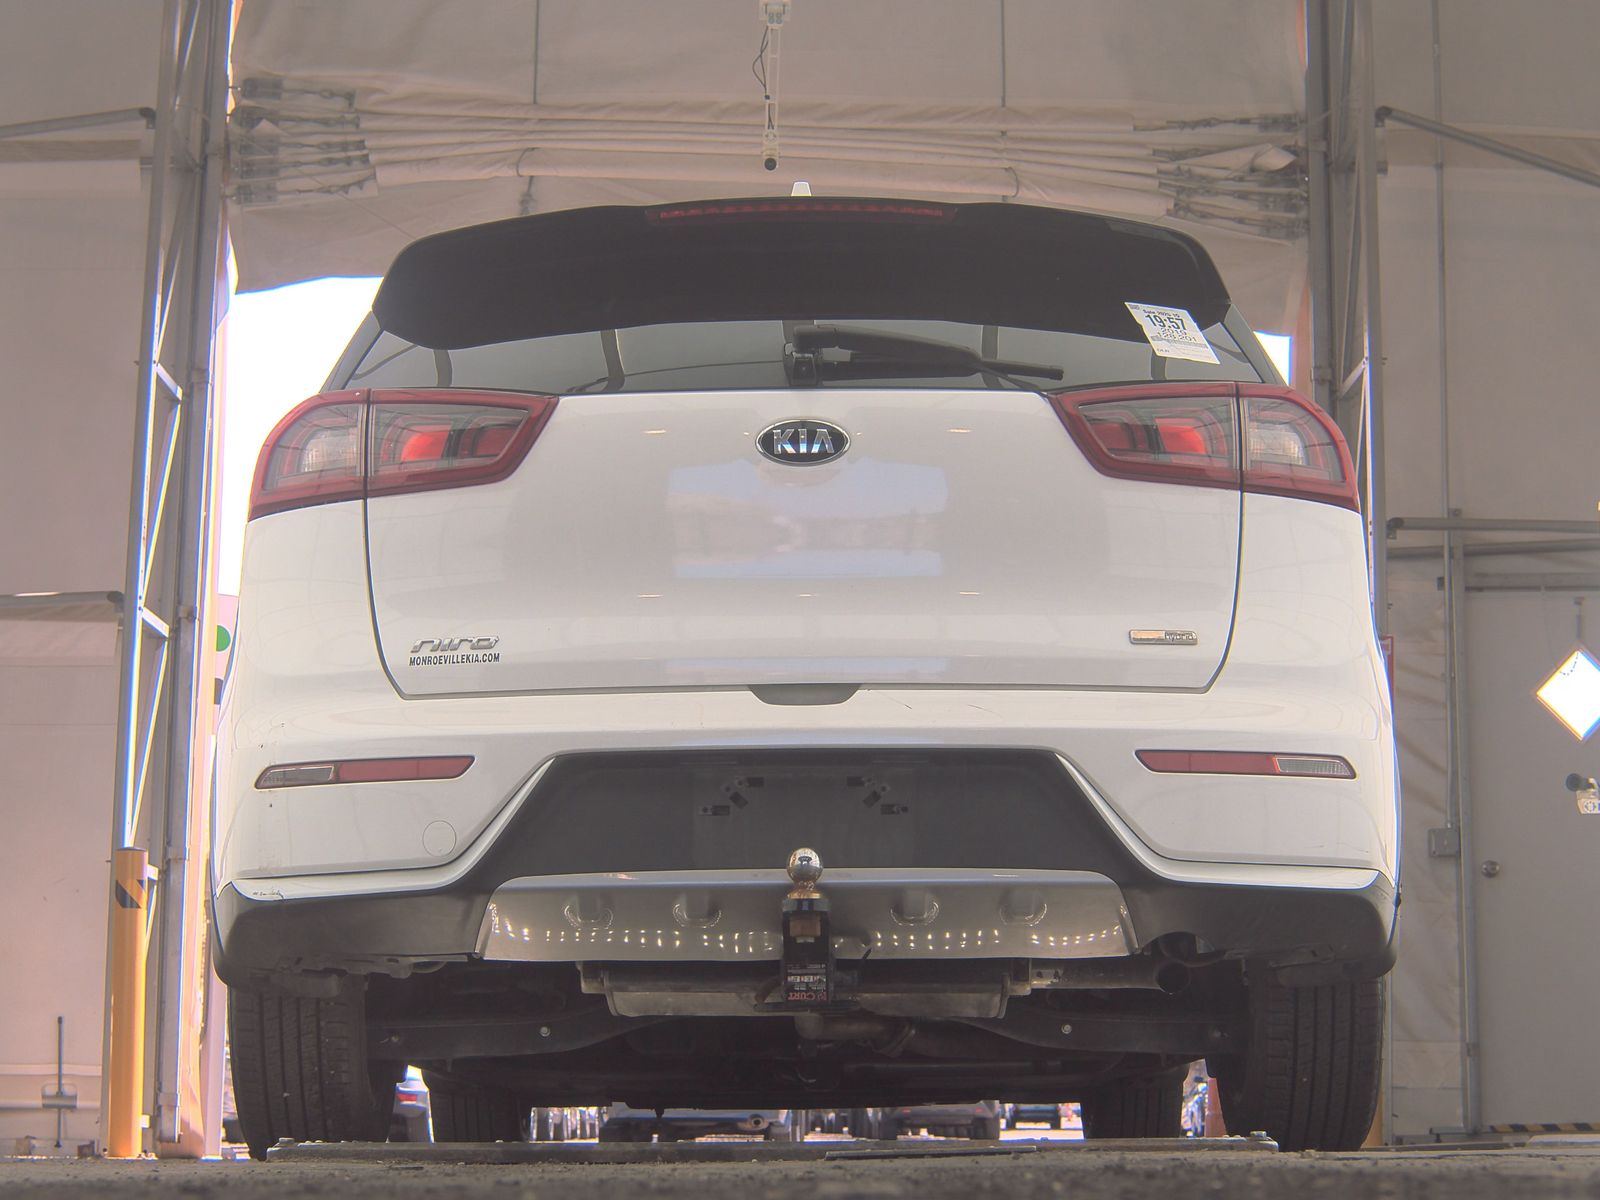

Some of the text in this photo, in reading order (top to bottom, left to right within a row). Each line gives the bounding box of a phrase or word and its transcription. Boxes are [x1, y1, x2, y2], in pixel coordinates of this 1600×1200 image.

[1145, 314, 1187, 330] 19:57
[772, 428, 835, 455] KIA
[410, 636, 500, 653] niro
[409, 652, 500, 666] MONROEVILLEKIA.COM
